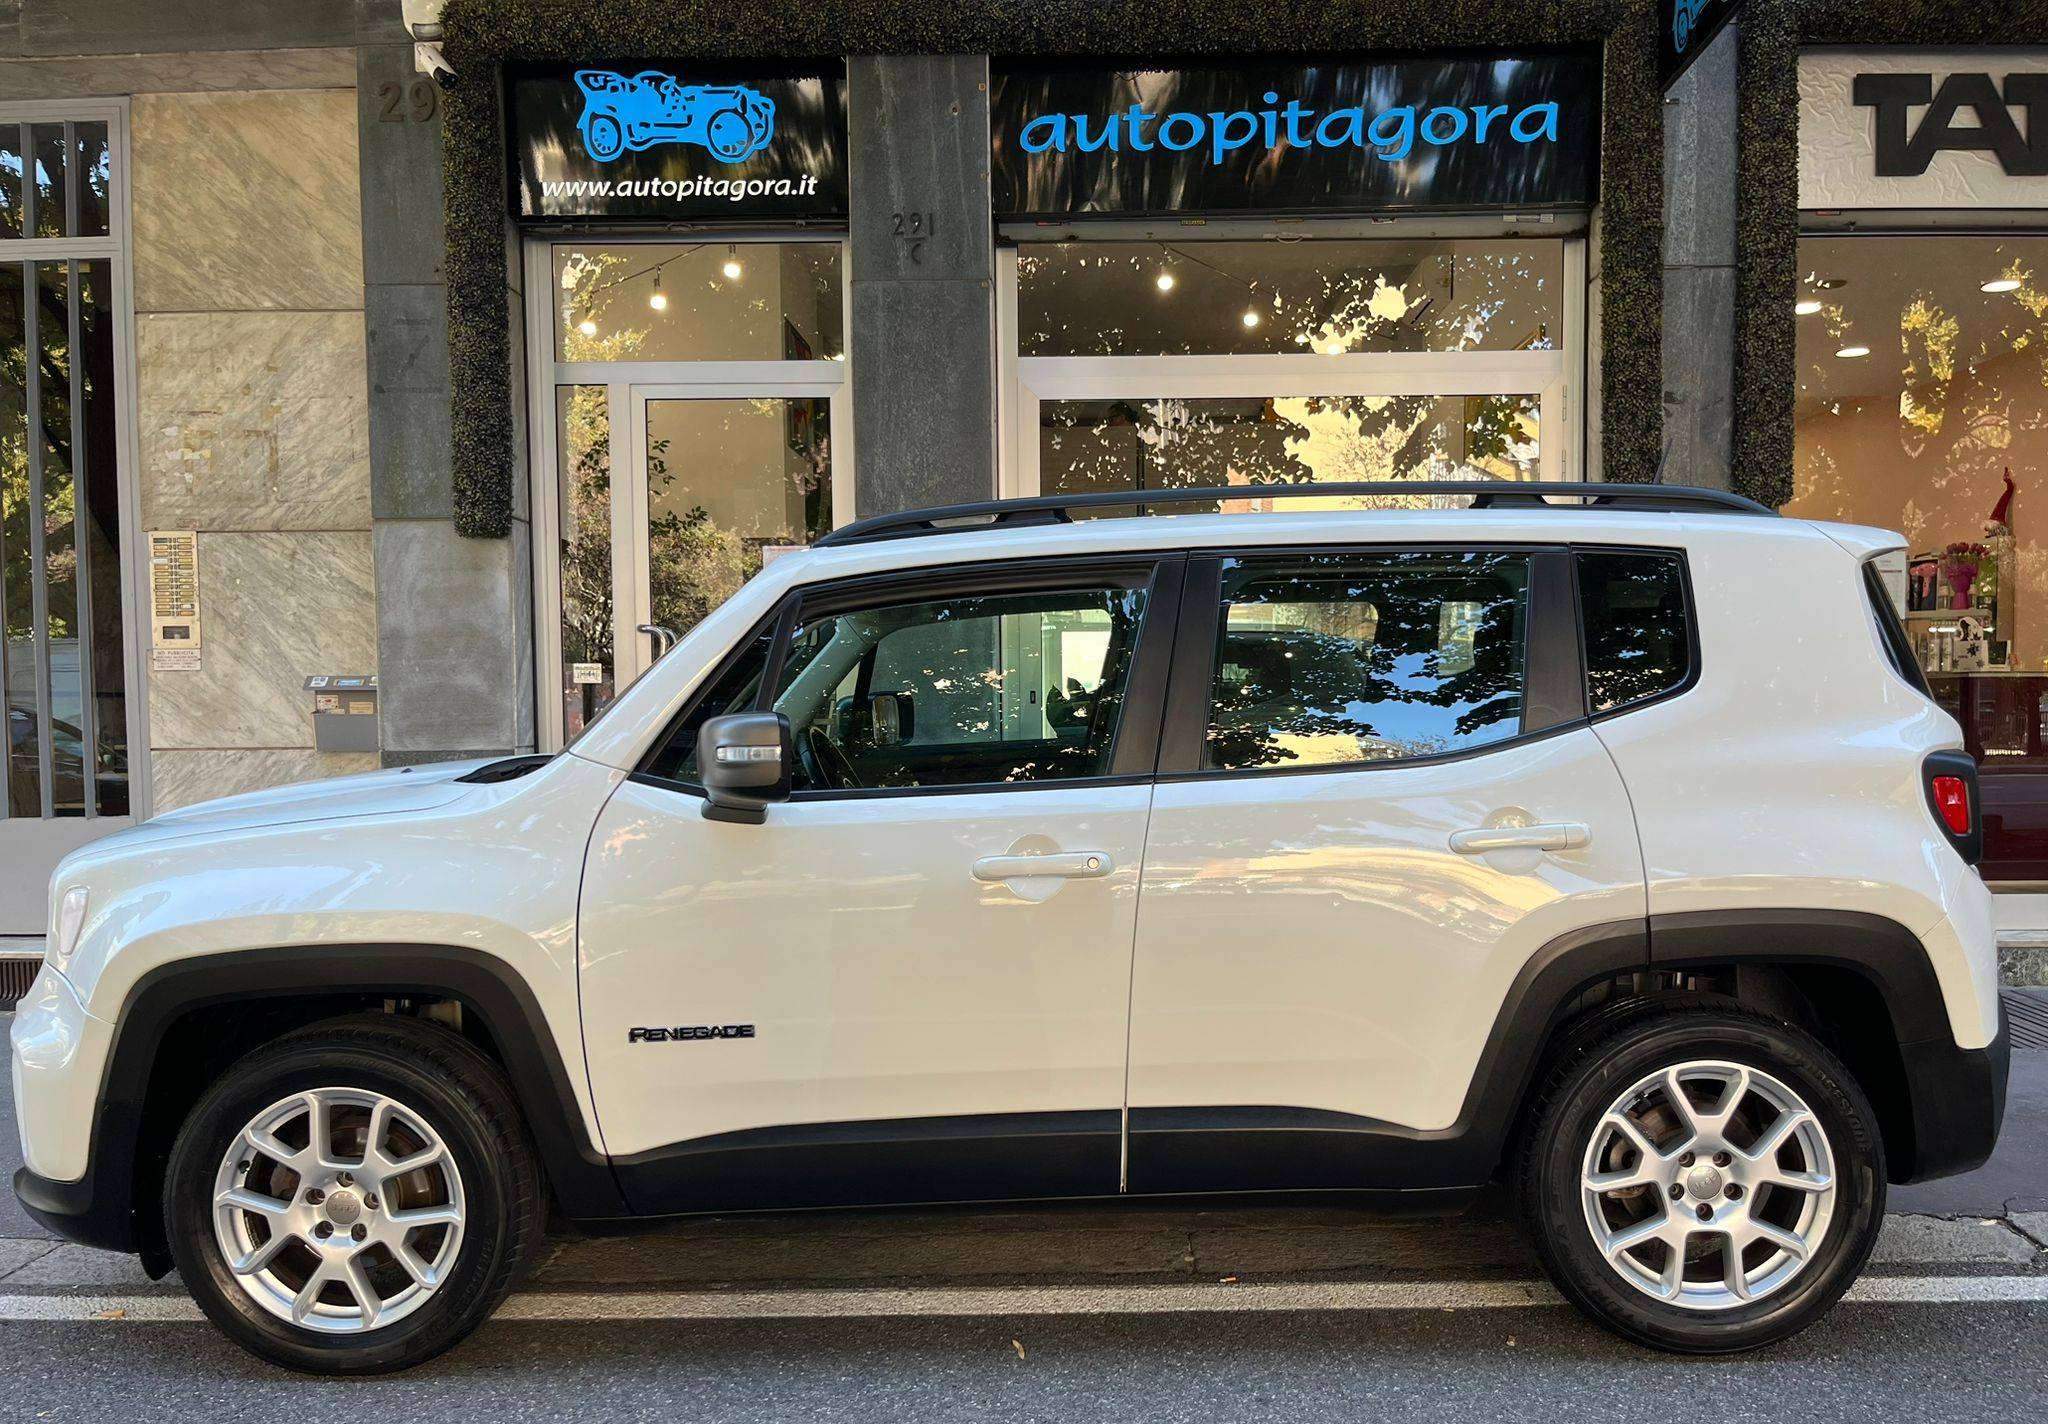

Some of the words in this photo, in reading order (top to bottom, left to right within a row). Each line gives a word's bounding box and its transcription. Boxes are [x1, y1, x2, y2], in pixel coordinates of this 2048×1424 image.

[379, 81, 436, 123] 29
[1020, 91, 1558, 165] autopitagora
[542, 174, 818, 201] www.autopitagora.it
[628, 1024, 756, 1044] RENEGADE
